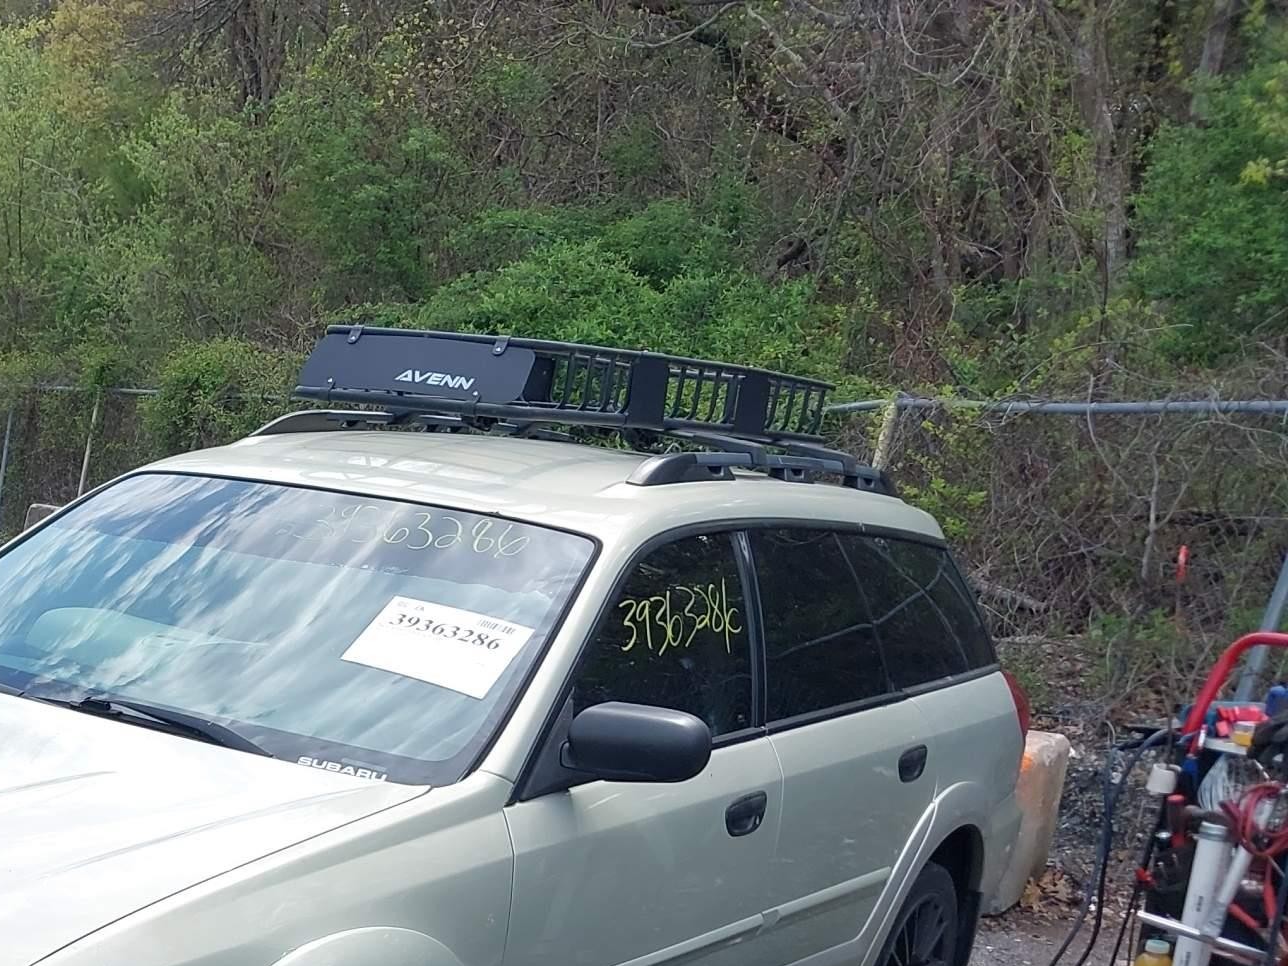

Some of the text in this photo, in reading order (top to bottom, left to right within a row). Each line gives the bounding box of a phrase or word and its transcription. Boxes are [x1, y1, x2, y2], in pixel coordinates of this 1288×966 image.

[394, 369, 475, 390] AVENN
[388, 613, 503, 650] 39363286
[618, 577, 742, 656] 39363286
[297, 756, 389, 782] SUBARU
